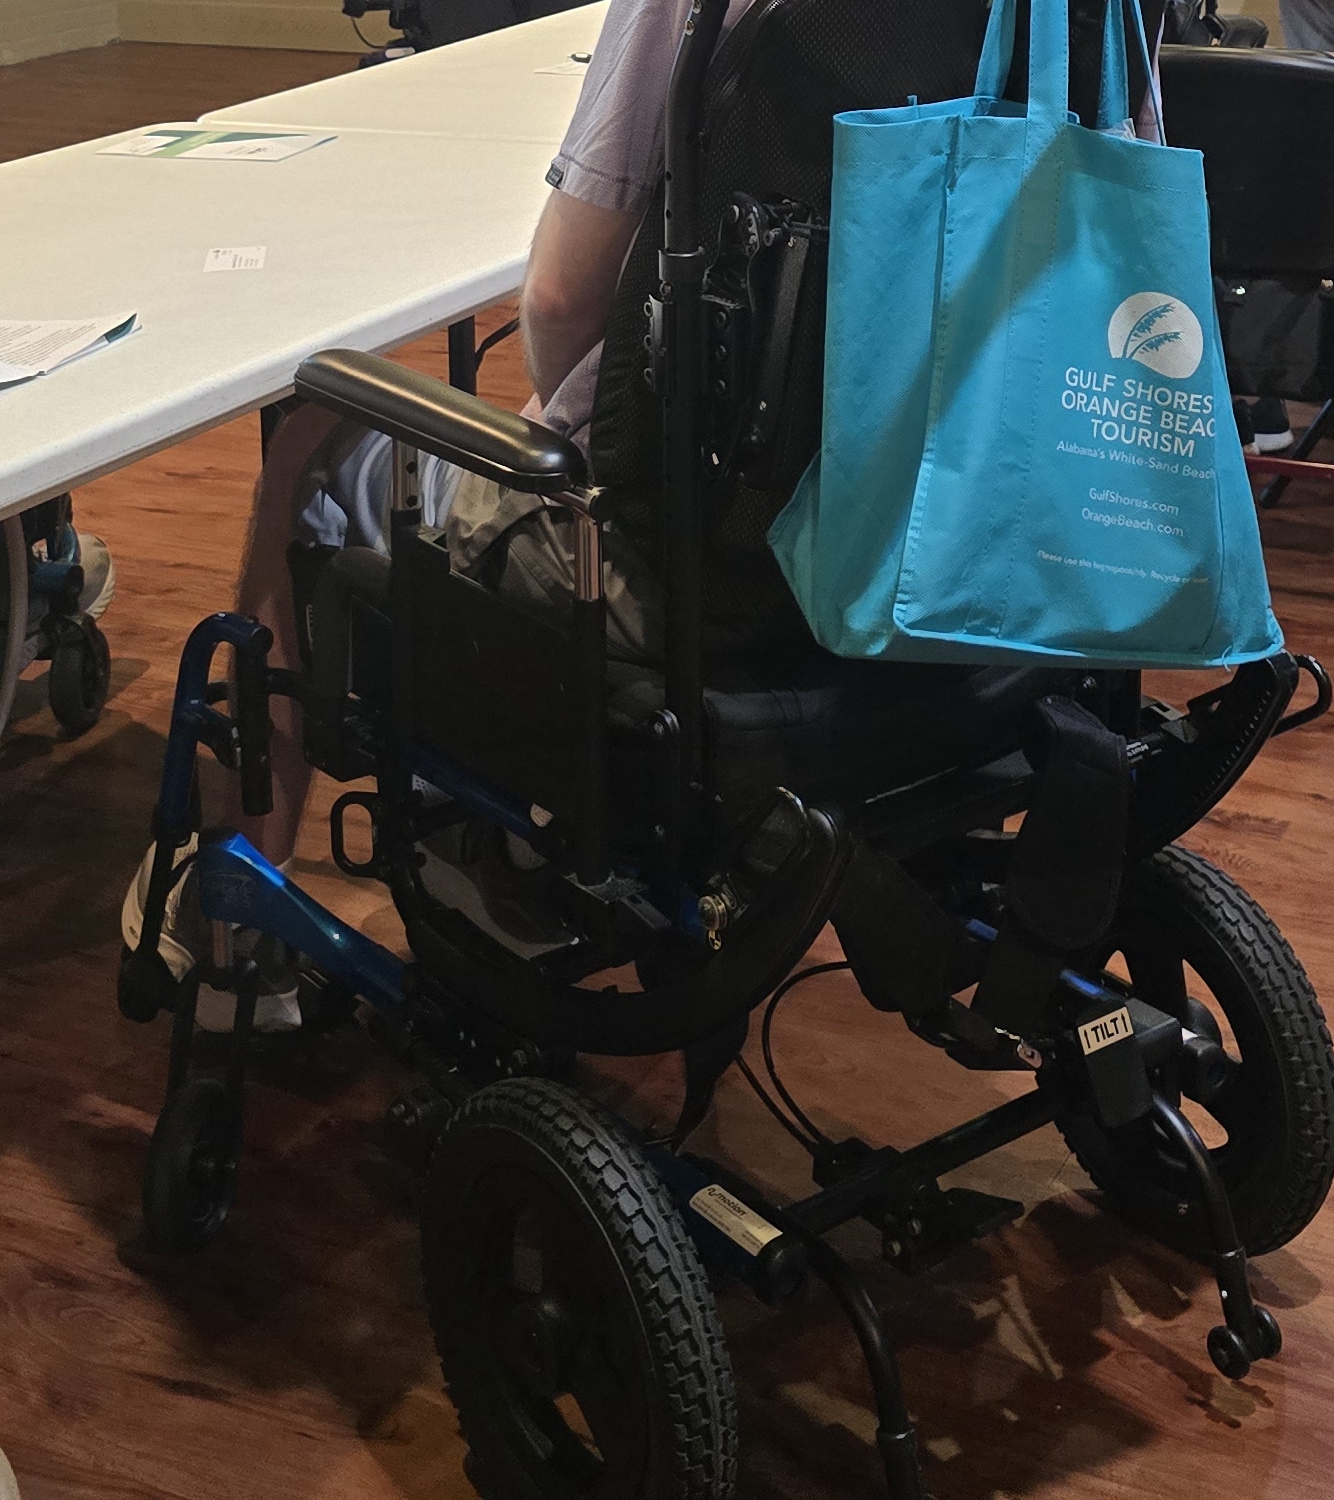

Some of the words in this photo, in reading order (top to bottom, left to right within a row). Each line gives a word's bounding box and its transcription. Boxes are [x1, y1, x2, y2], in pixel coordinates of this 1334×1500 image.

[1065, 366, 1117, 393] GULF
[1122, 378, 1214, 414] SHORES
[1061, 389, 1153, 425] ORANGE
[1160, 411, 1216, 438] BEAC
[1091, 418, 1195, 458] TOURISM
[1056, 440, 1106, 460] Alabama's
[1108, 449, 1180, 475] White-Sand
[1181, 465, 1216, 480] Beach
[1089, 487, 1180, 516] GulfShores.com
[1081, 507, 1185, 537] OrangeBeach.com
[1090, 1016, 1120, 1043] TILT
